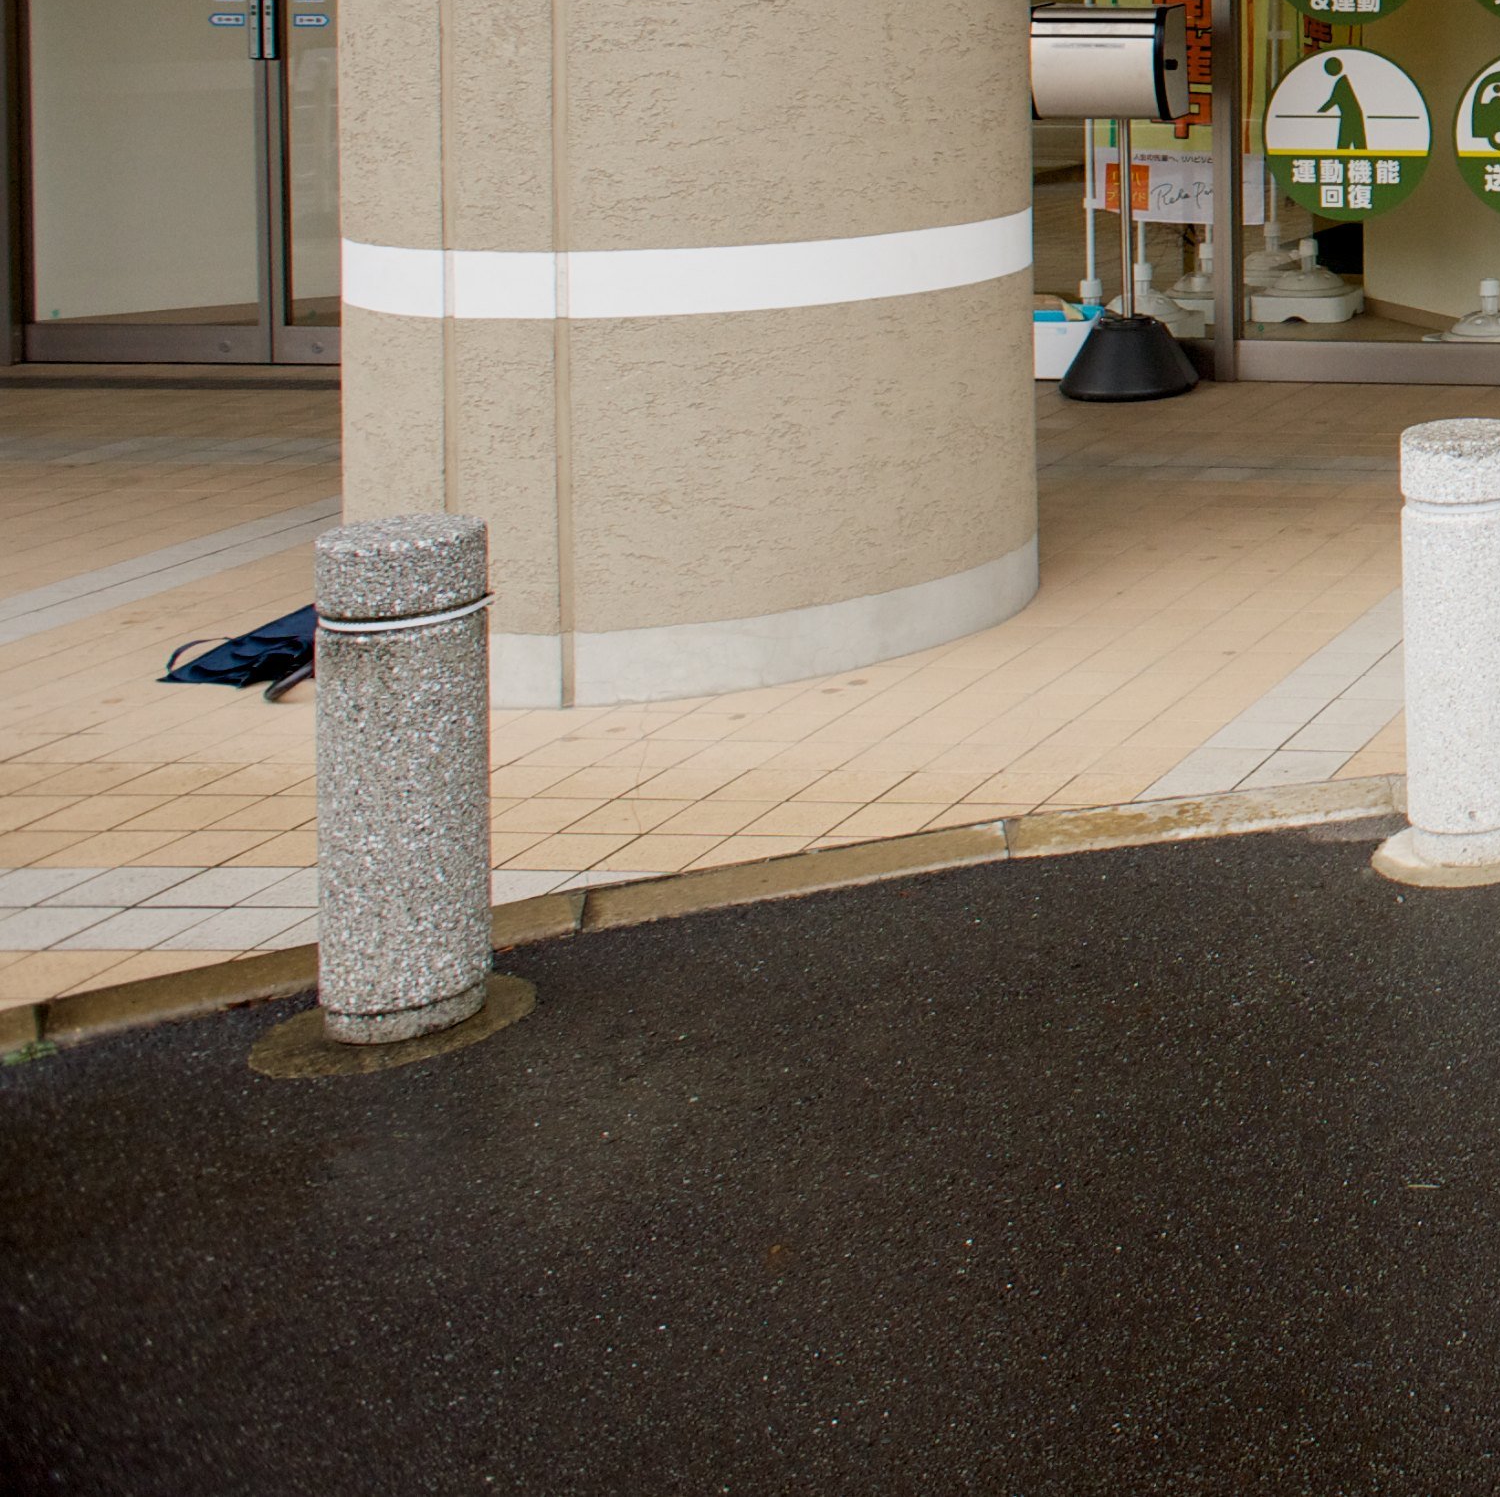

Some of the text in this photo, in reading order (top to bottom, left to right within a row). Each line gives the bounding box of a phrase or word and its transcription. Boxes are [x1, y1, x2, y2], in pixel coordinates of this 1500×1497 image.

[1291, 159, 1400, 185] 運動機能
[1320, 185, 1373, 209] 回復
